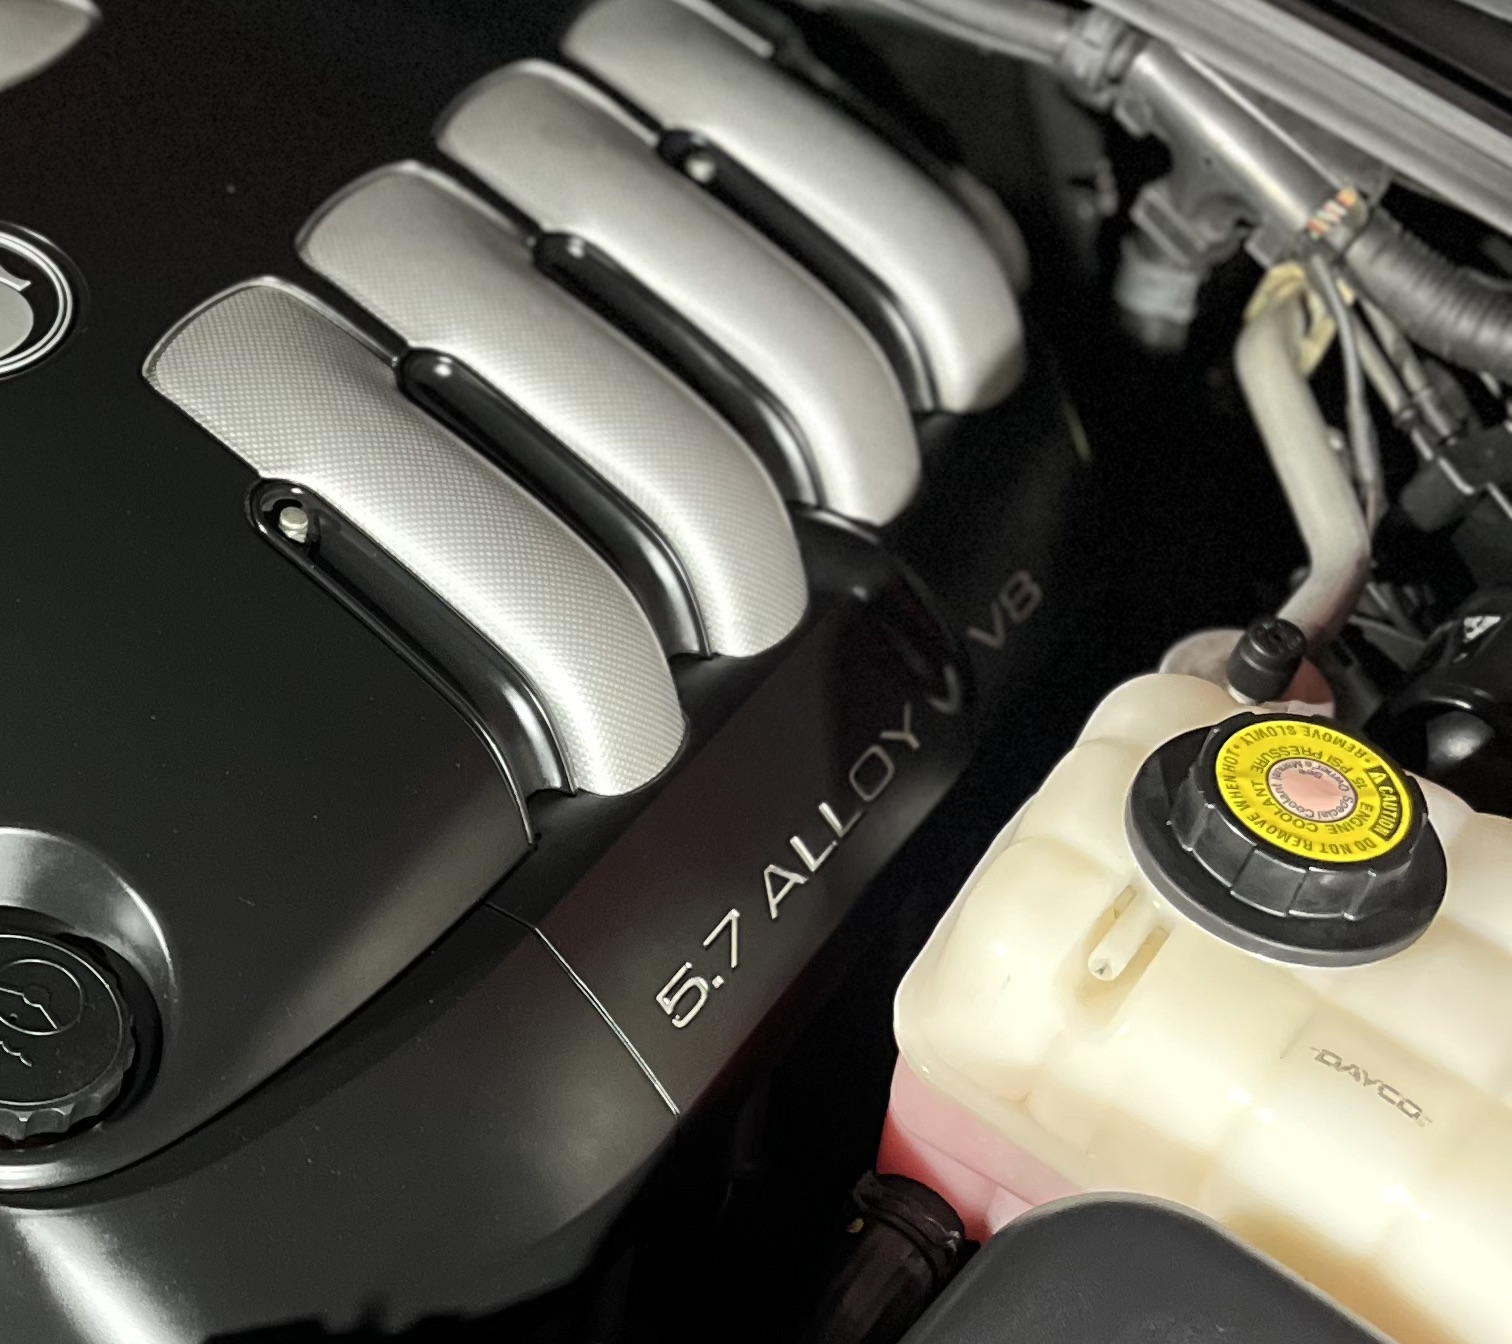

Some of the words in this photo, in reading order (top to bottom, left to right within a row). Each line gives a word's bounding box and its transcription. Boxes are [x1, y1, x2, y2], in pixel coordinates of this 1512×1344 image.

[1241, 725, 1297, 747] SLOWLY
[1303, 726, 1364, 759] REMOVE
[1222, 748, 1239, 772] HOT
[1251, 745, 1323, 774] PRESSURE
[1326, 756, 1354, 774] PSI
[656, 908, 740, 1028] 5.7
[763, 703, 918, 918] ALLOY
[967, 571, 1042, 650] V8
[1228, 775, 1252, 811] WHEN
[1251, 780, 1318, 832] COOLANT
[1272, 782, 1316, 819] Coolant
[1317, 795, 1354, 821] Special
[1327, 803, 1374, 834] ENGINE
[1374, 786, 1398, 839] CAUTION
[1248, 814, 1313, 850] REMOVE
[1320, 840, 1353, 855] NOT
[1355, 836, 1377, 852] DO
[1314, 1049, 1424, 1119] DAYCO
